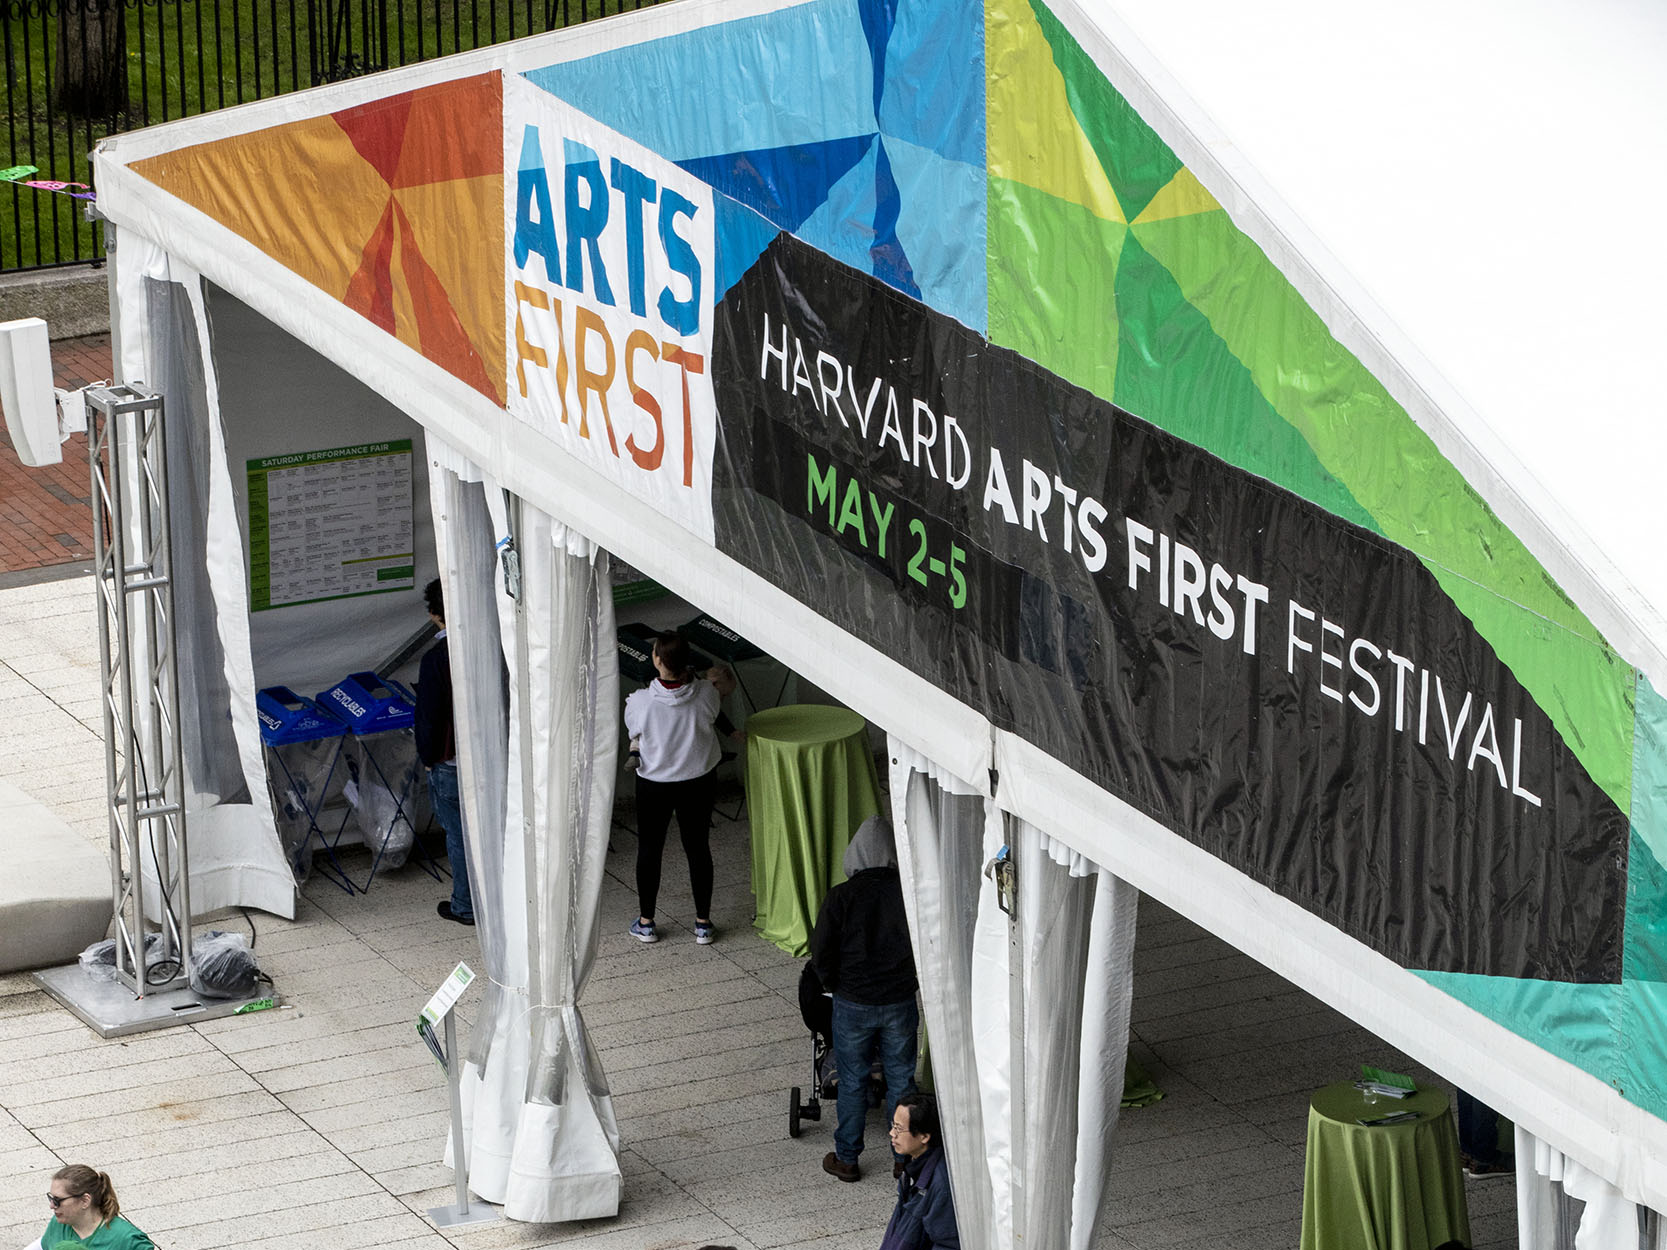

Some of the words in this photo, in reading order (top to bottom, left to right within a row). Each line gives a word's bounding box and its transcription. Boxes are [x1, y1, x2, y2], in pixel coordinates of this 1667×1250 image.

[514, 124, 699, 337] ARTS
[261, 455, 303, 467] SATURDAY
[306, 446, 368, 461] PERFORMANCE
[370, 443, 389, 452] FAIR
[515, 280, 704, 488] FIRST
[760, 313, 970, 490] HARVARD
[983, 447, 1109, 573] ARTS
[1128, 516, 1269, 655] FIRST
[1288, 600, 1541, 807] FESTIVAL
[806, 454, 894, 560] MAY
[907, 518, 967, 610] 2-5
[330, 688, 366, 717] RECYCLABLES
[699, 619, 740, 643] COMPOSTABLES
